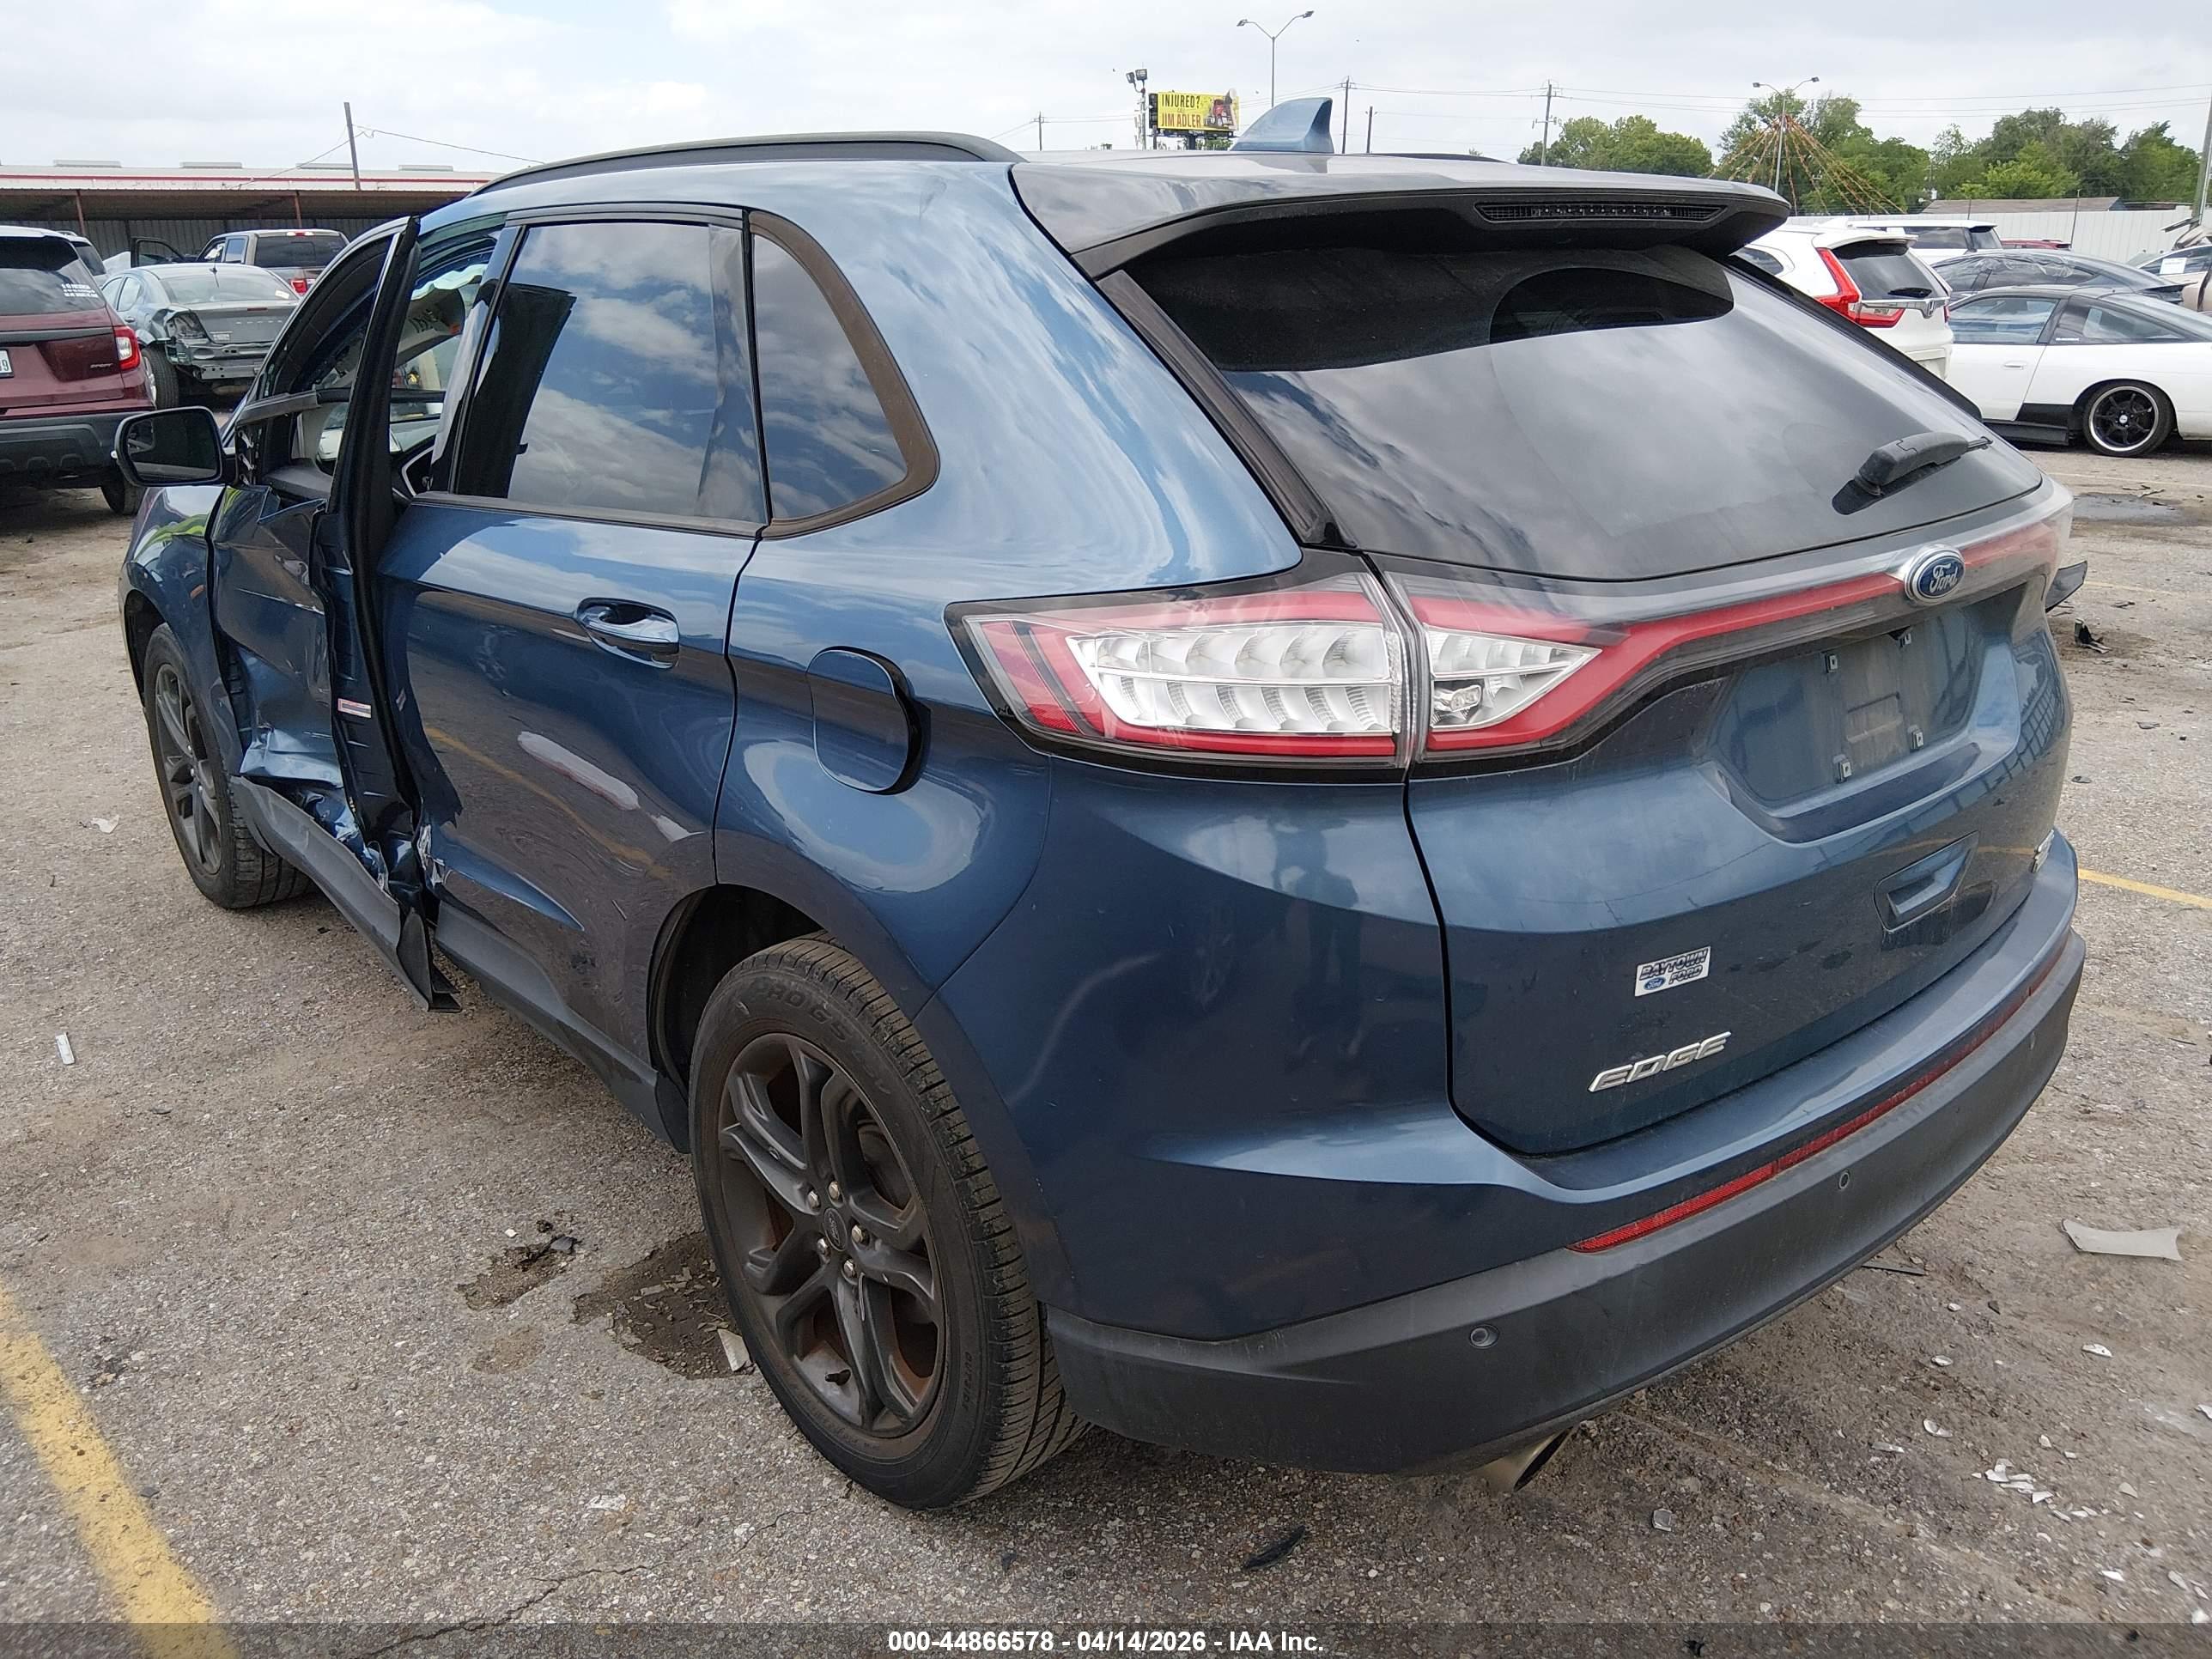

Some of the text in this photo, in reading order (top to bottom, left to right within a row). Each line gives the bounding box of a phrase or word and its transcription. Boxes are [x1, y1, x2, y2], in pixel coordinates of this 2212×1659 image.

[1162, 94, 1200, 109] INJURED?
[1161, 112, 1201, 128] JIM ADLER
[1929, 562, 1959, 593] Ford
[1639, 948, 1708, 981] BAYTOWN
[1647, 979, 1663, 990] Ford
[1668, 965, 1703, 985] FORD
[1588, 1031, 1732, 1092] EDGE
